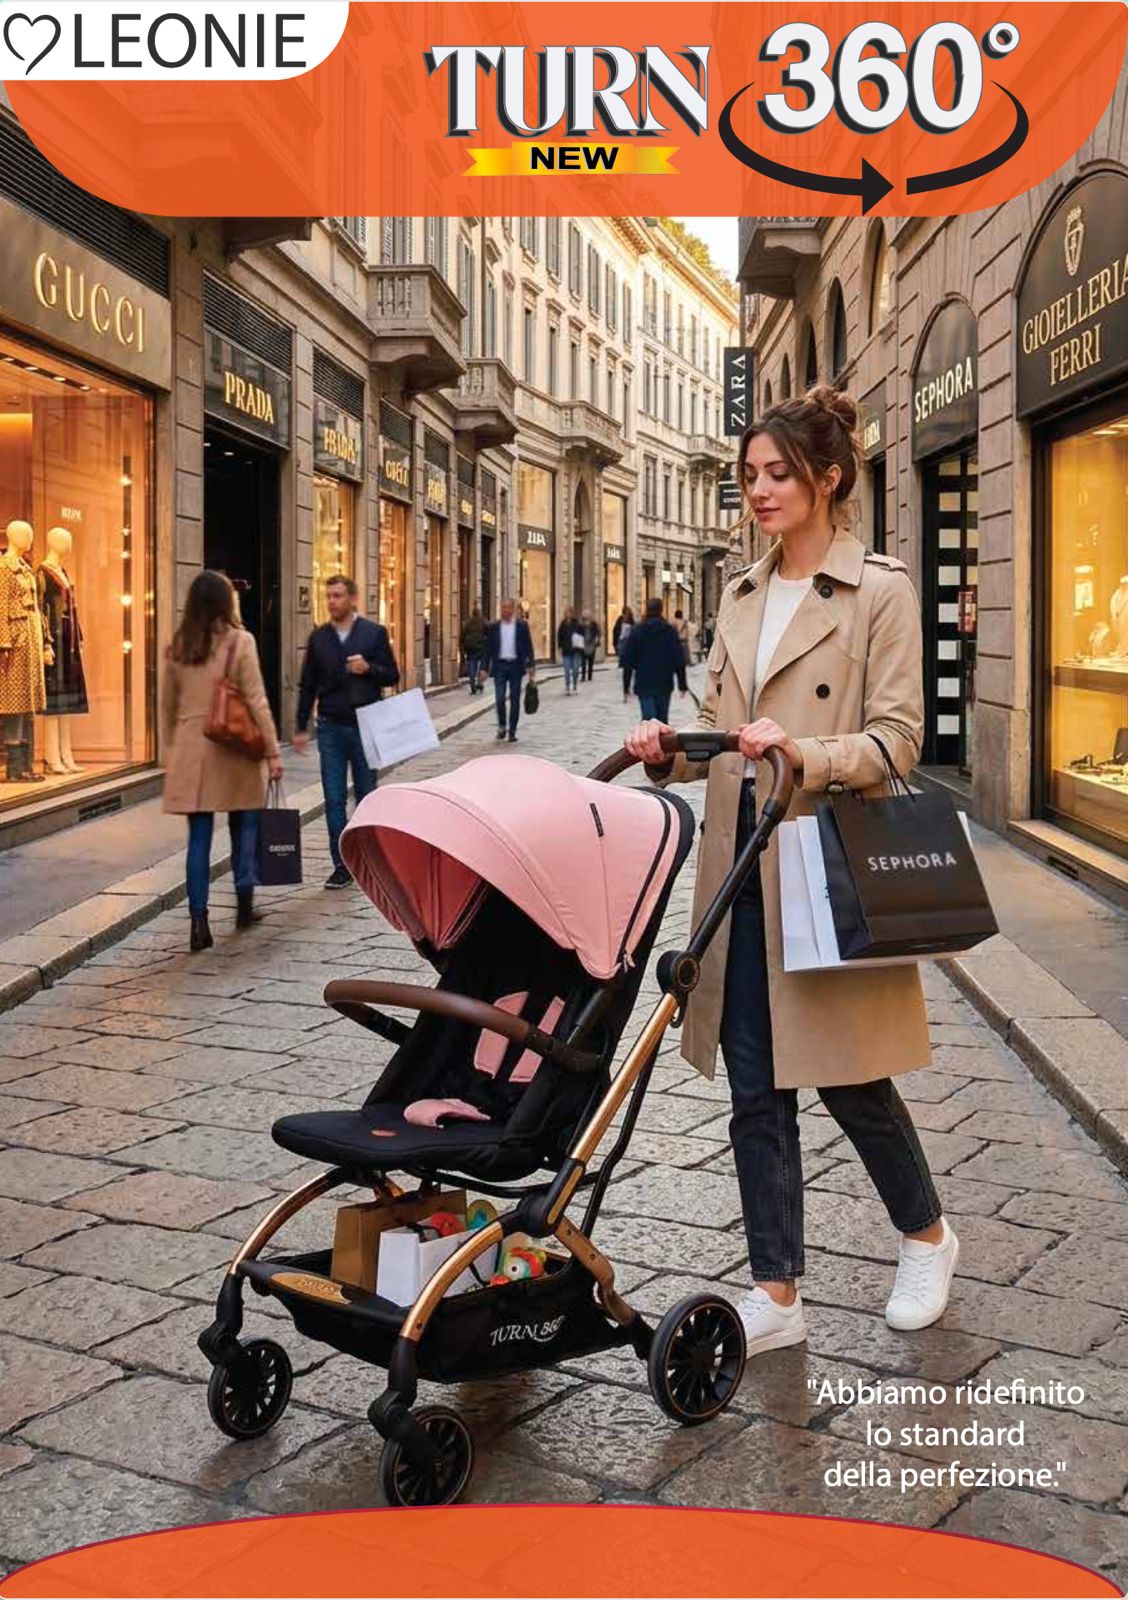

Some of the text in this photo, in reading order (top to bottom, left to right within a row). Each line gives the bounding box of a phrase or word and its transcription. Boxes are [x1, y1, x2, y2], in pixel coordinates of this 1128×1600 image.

[34, 252, 144, 353] GUCCI
[1050, 323, 1102, 386] FERRI
[224, 371, 274, 424] PRADA
[730, 354, 747, 427] ZARA
[914, 356, 974, 424] SEPHORA
[867, 852, 958, 872] SEPHORA
[490, 1324, 539, 1347] TURN
